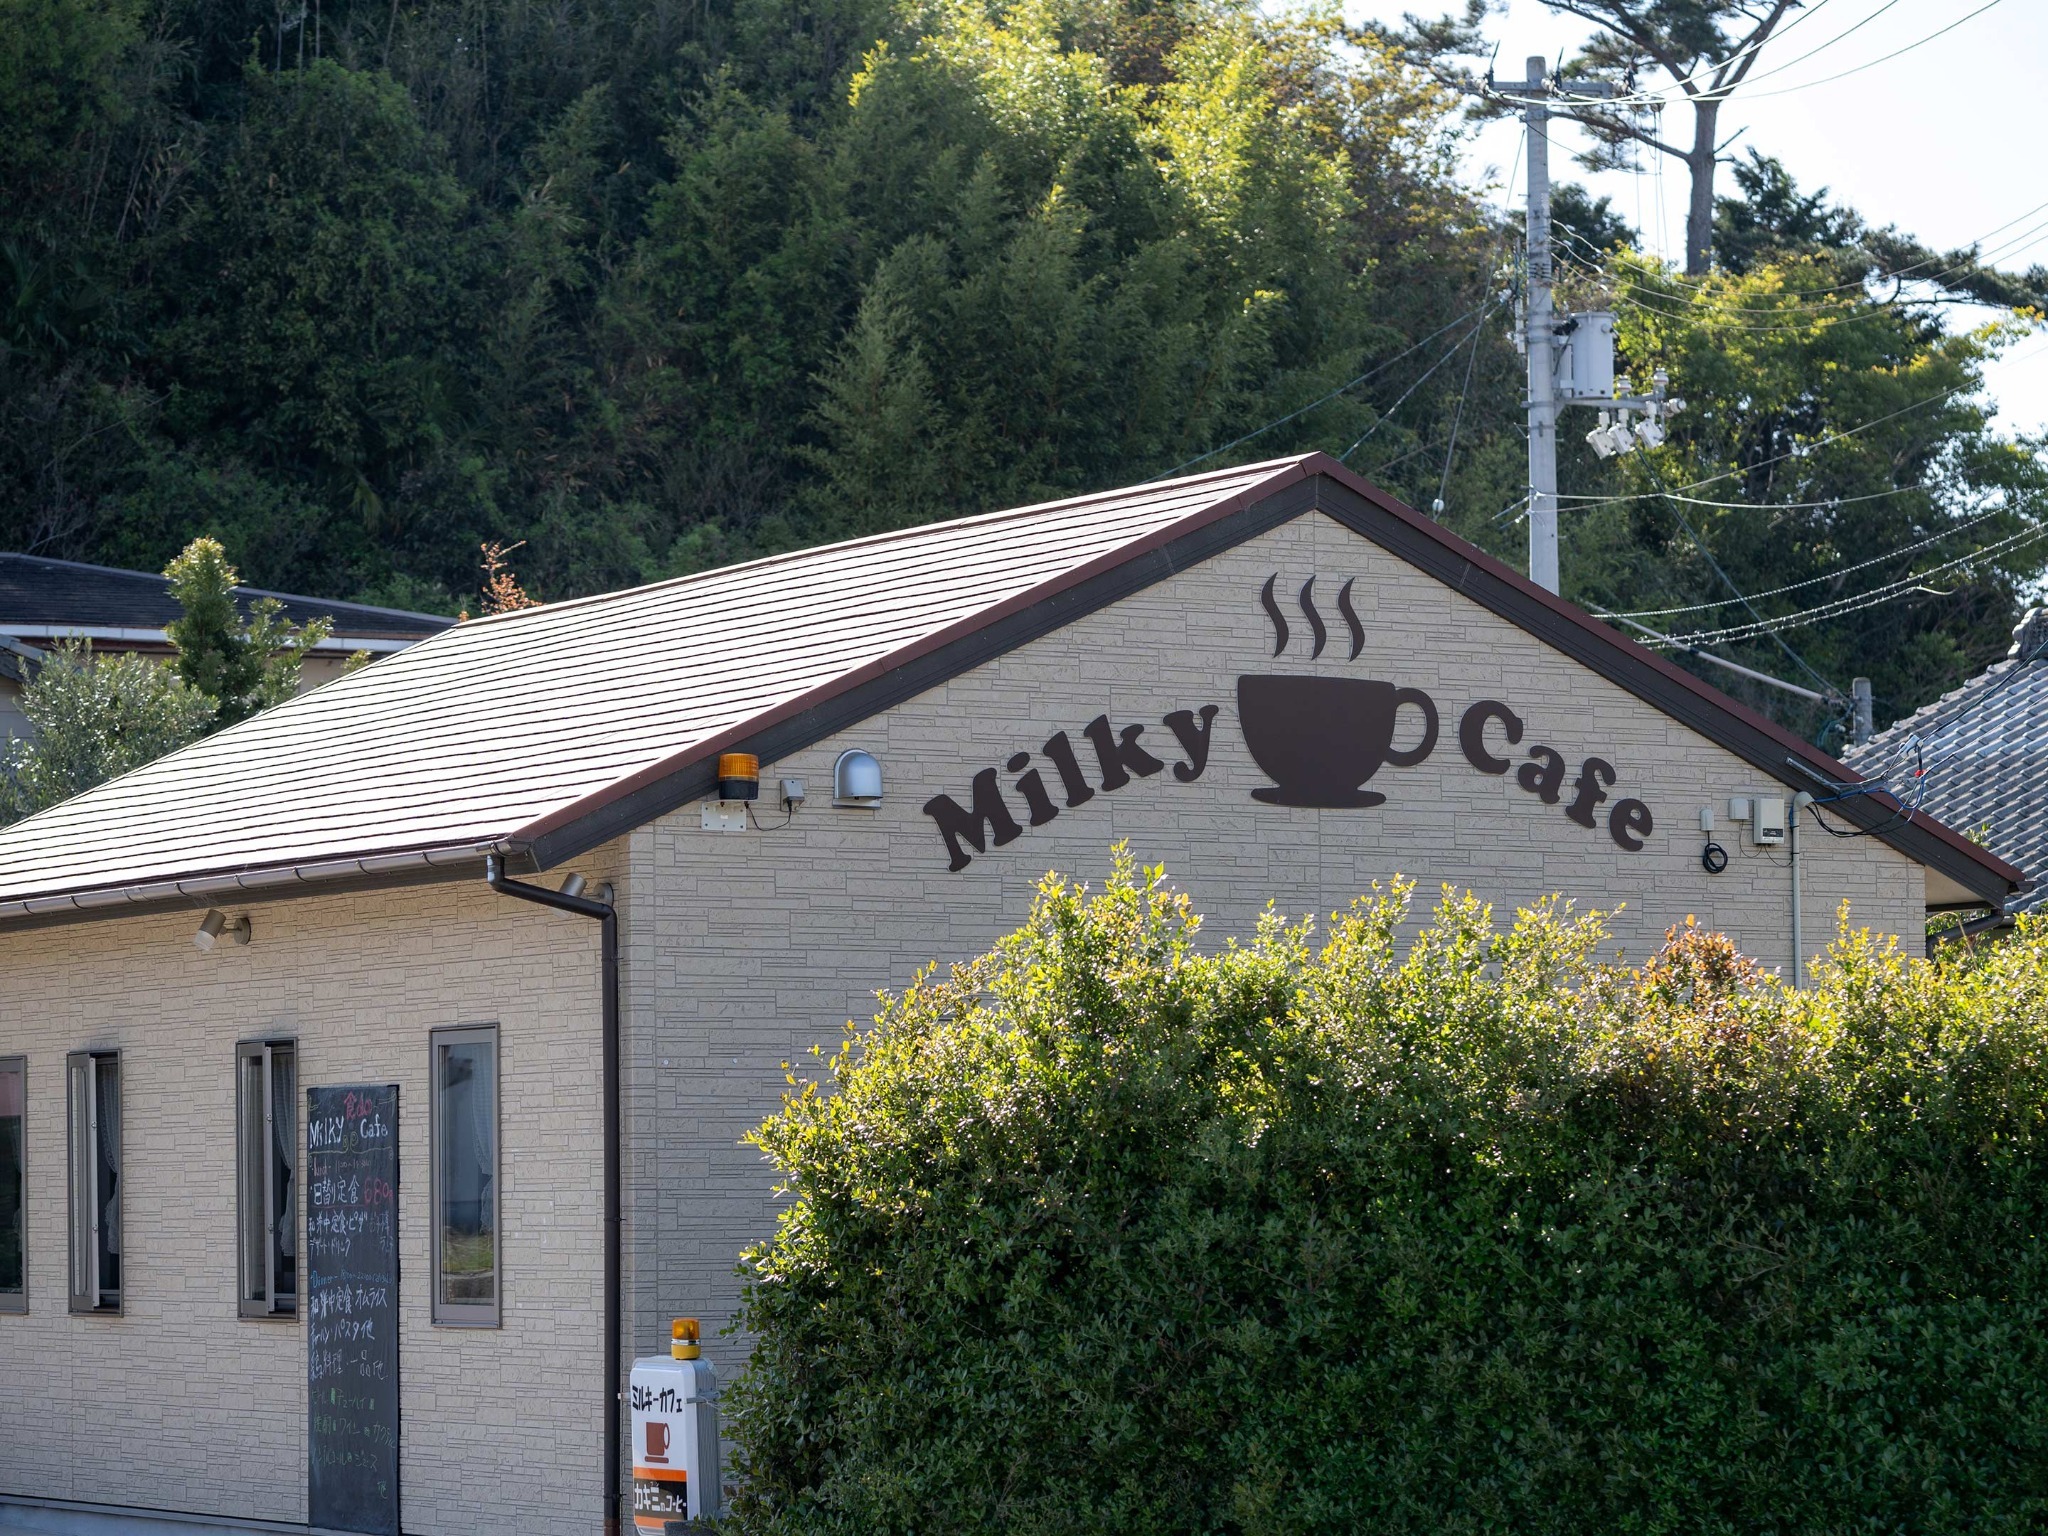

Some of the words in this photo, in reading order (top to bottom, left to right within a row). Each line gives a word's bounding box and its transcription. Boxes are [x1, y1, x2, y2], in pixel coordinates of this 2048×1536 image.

[923, 704, 1219, 872] Milky
[1459, 700, 1653, 851] Cafe
[360, 1113, 388, 1139] Cafe
[632, 1385, 682, 1413] ミルキーカフェ
